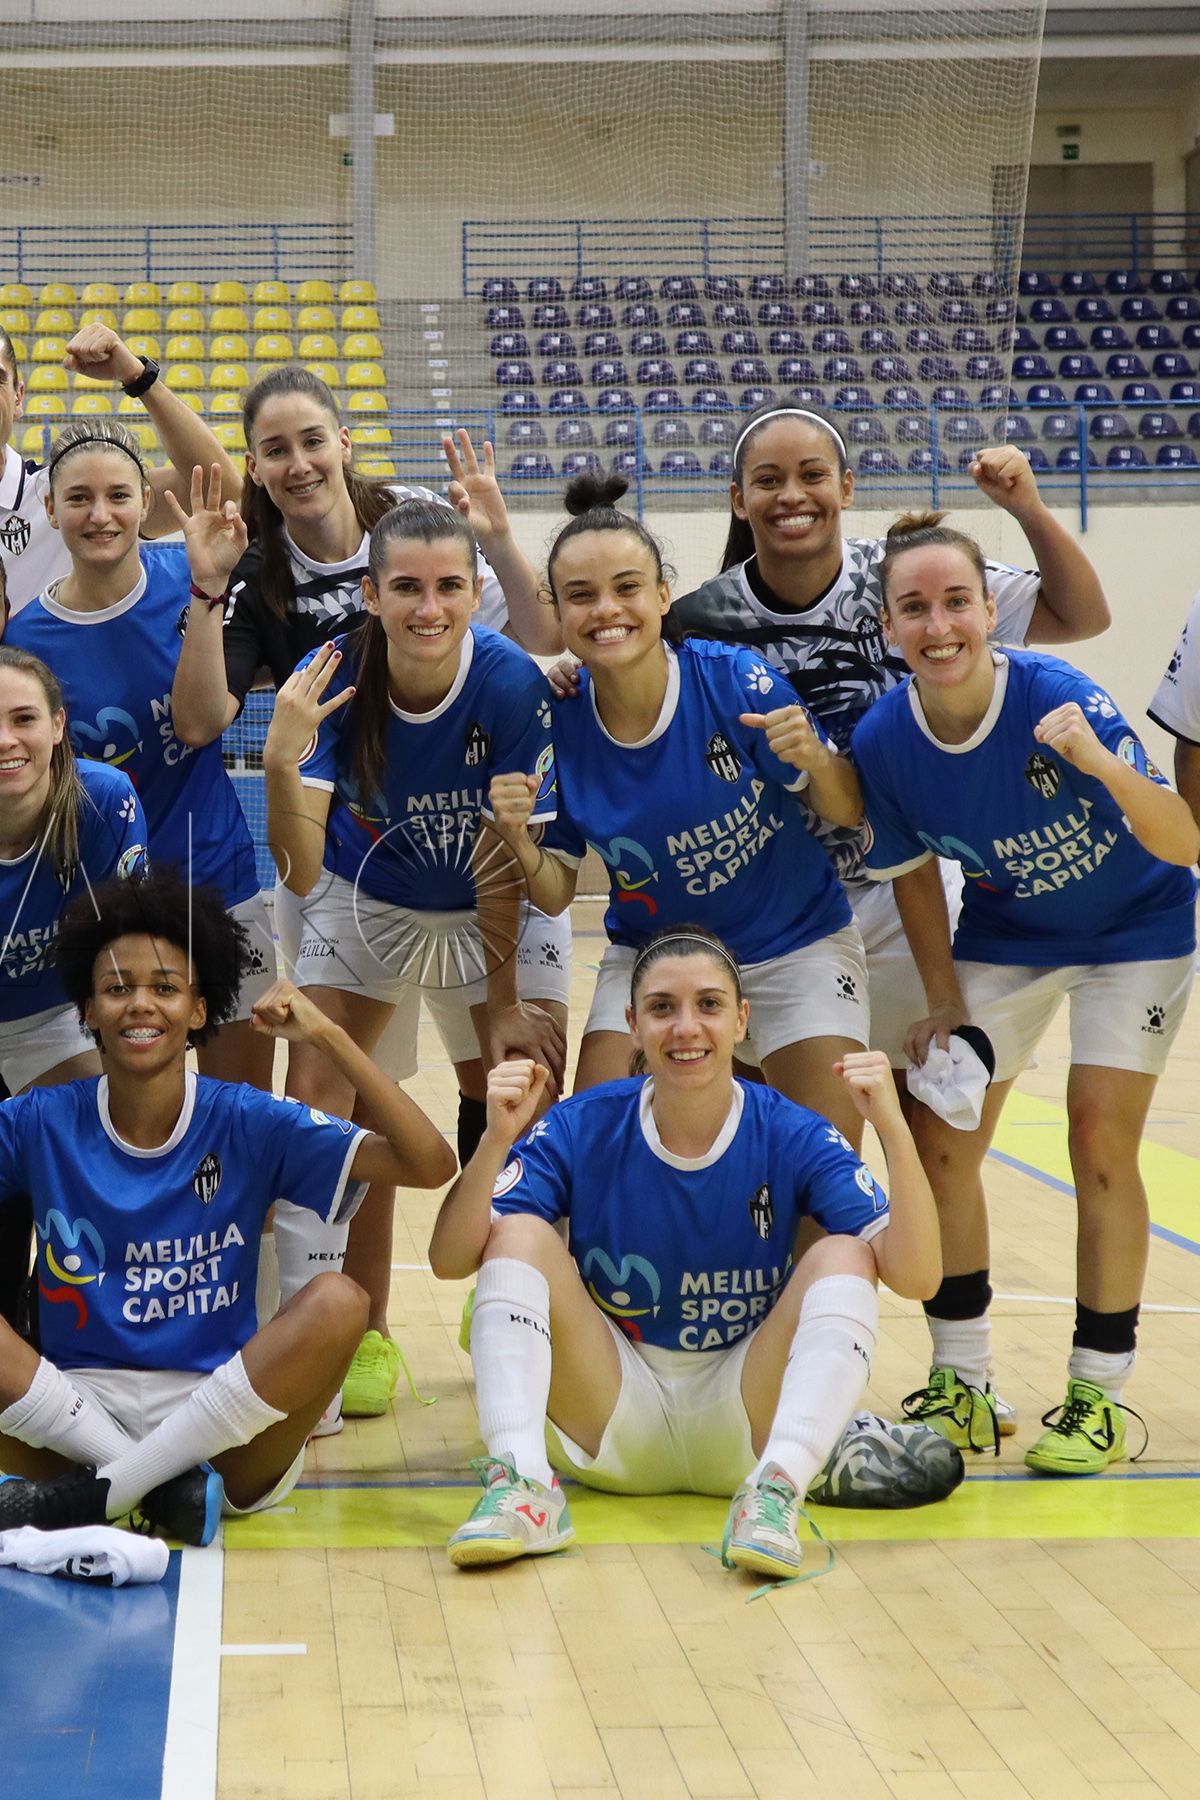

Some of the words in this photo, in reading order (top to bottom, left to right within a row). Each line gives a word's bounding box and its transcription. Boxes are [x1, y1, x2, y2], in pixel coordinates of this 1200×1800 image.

[666, 778, 766, 837] MELILLA
[993, 797, 1094, 859] MELILLA
[676, 810, 760, 878] SPORT
[685, 813, 785, 896] CAPITAL
[1005, 827, 1093, 880] SPORT
[1014, 829, 1118, 898] CAPITAL
[124, 1222, 246, 1262] MELILLA
[308, 1251, 346, 1262] KELM
[124, 1255, 222, 1292] SPORT
[122, 1281, 240, 1324] CAPITAL
[510, 1314, 550, 1342] KELM
[678, 1319, 754, 1352] CAPI
